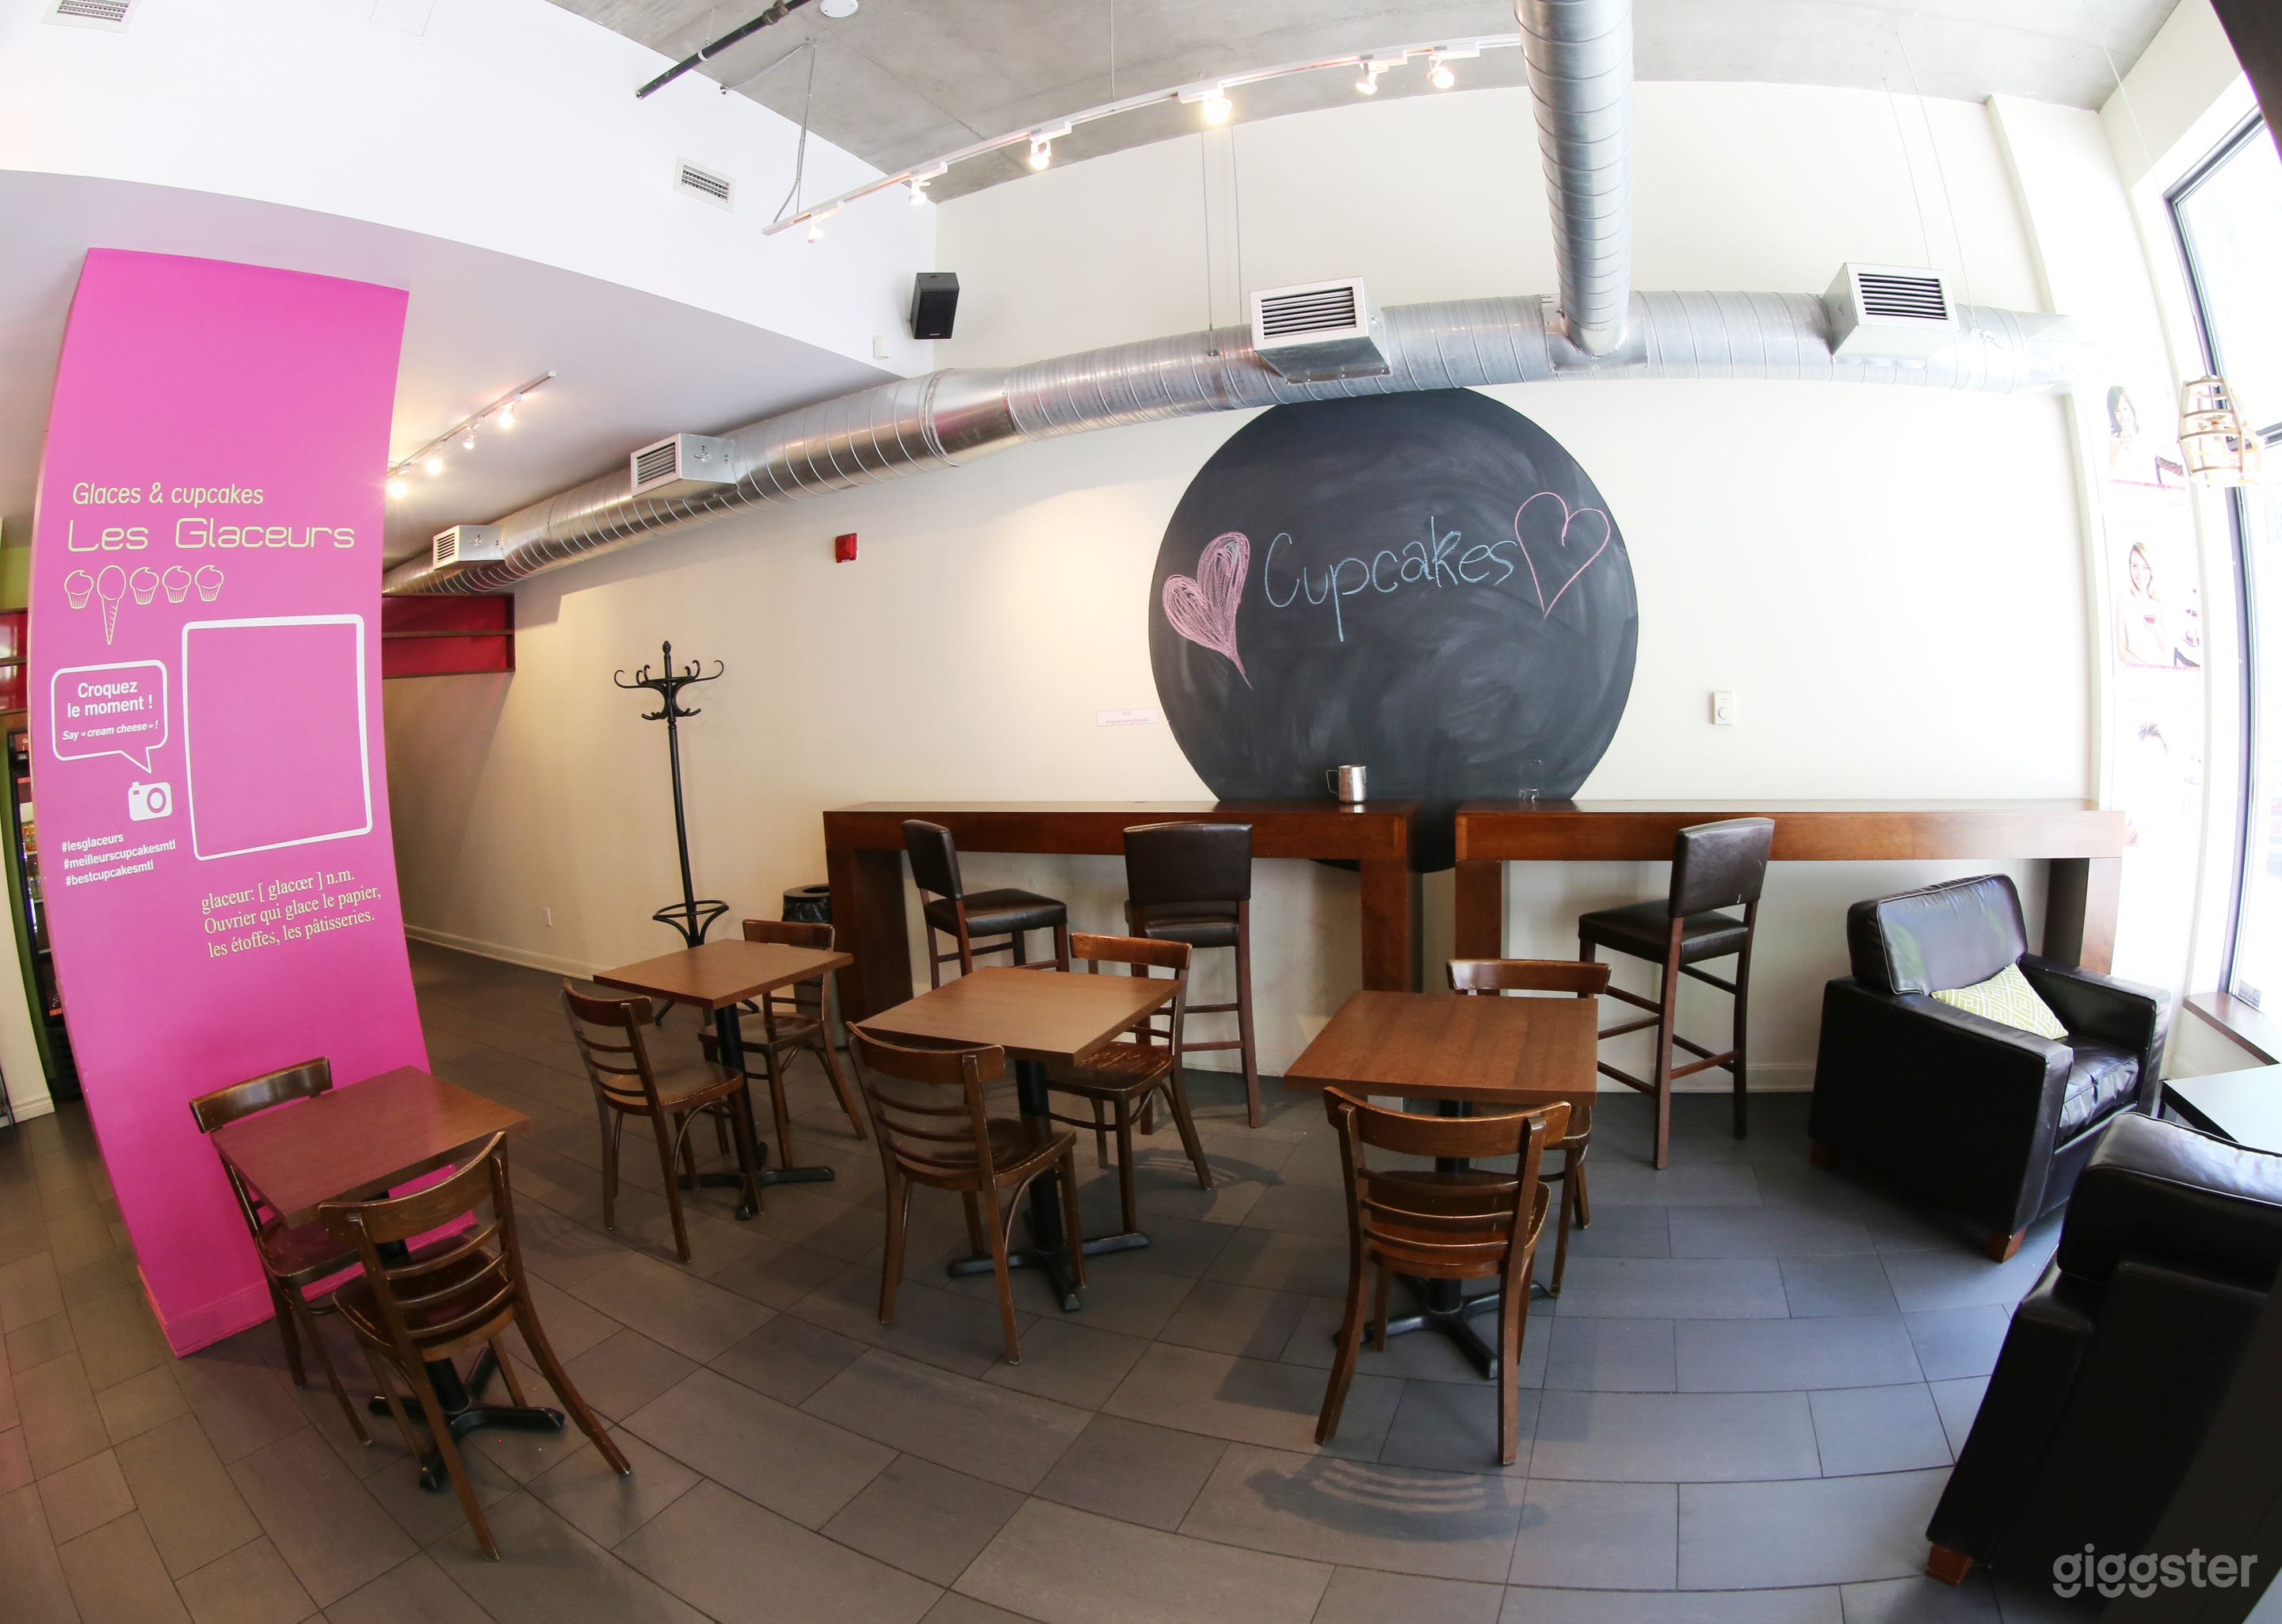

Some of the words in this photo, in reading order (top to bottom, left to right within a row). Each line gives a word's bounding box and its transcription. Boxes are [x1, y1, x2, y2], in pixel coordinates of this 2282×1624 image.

[72, 482, 142, 505] Glaces
[149, 482, 164, 504] &
[171, 483, 264, 509] cupcakes
[68, 519, 149, 552] Les
[175, 517, 355, 549] Glaceurs
[1265, 515, 1517, 642] Cupcakes
[77, 680, 138, 699] Croquez
[67, 703, 81, 719] le
[85, 696, 144, 716] moment
[63, 730, 78, 741] Say
[62, 833, 124, 852] #lesglaceurs
[63, 839, 176, 869] #meilleurscupcakesmtl
[66, 860, 155, 886] #bestcupcakesmtl
[201, 889, 254, 914] glaceur:
[204, 911, 257, 934] Ouvrier
[260, 902, 281, 925] qui
[285, 899, 319, 921] glace
[322, 893, 334, 909] le
[338, 885, 381, 909] papier,
[208, 941, 227, 958] les
[231, 930, 280, 952] étoffes,
[283, 924, 302, 940] les
[304, 909, 375, 940] pâtisseries.
